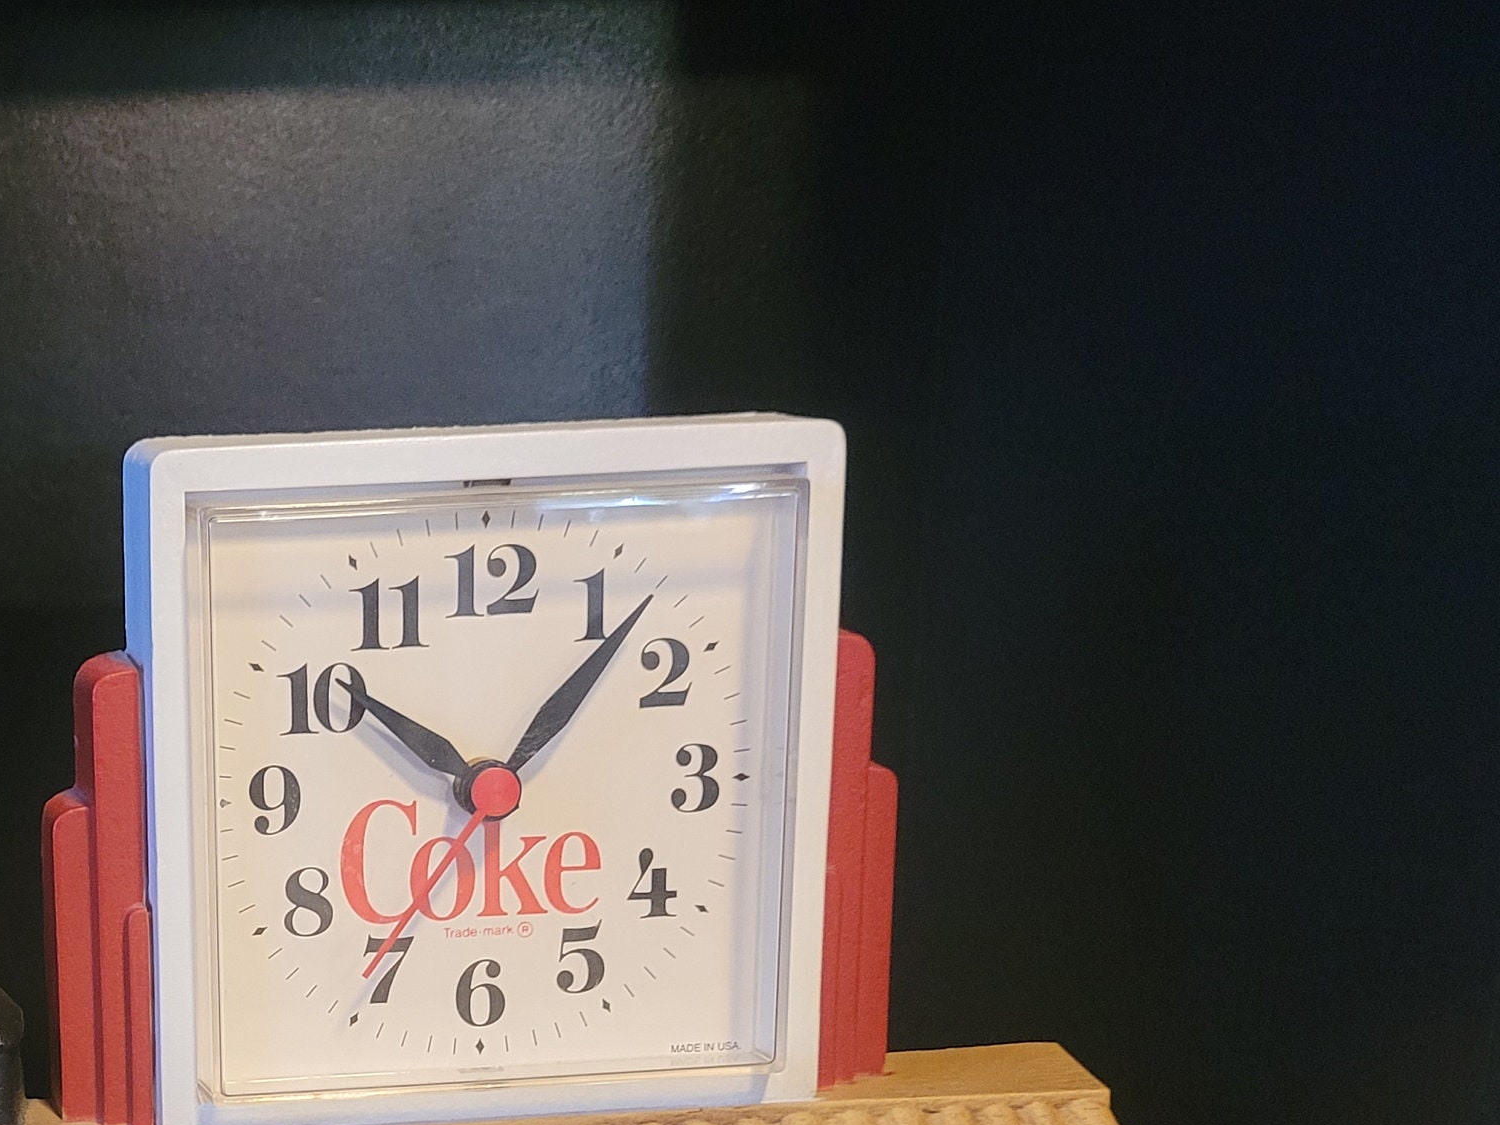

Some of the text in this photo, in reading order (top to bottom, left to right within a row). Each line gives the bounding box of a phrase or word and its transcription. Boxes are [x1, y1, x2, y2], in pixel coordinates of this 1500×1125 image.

[349, 575, 429, 652] 11
[444, 543, 539, 618] 12
[573, 568, 608, 644] 1
[277, 663, 368, 736] 10
[639, 637, 692, 709] 2
[248, 765, 301, 836] 9
[671, 743, 720, 813] 3
[339, 798, 602, 925] Coke
[627, 847, 678, 919] 4
[284, 867, 334, 937] 8
[363, 934, 415, 1004] 7
[556, 919, 605, 994] 5
[455, 959, 506, 1027] 6
[670, 1043, 701, 1053] MADE
[703, 1042, 715, 1052] IN
